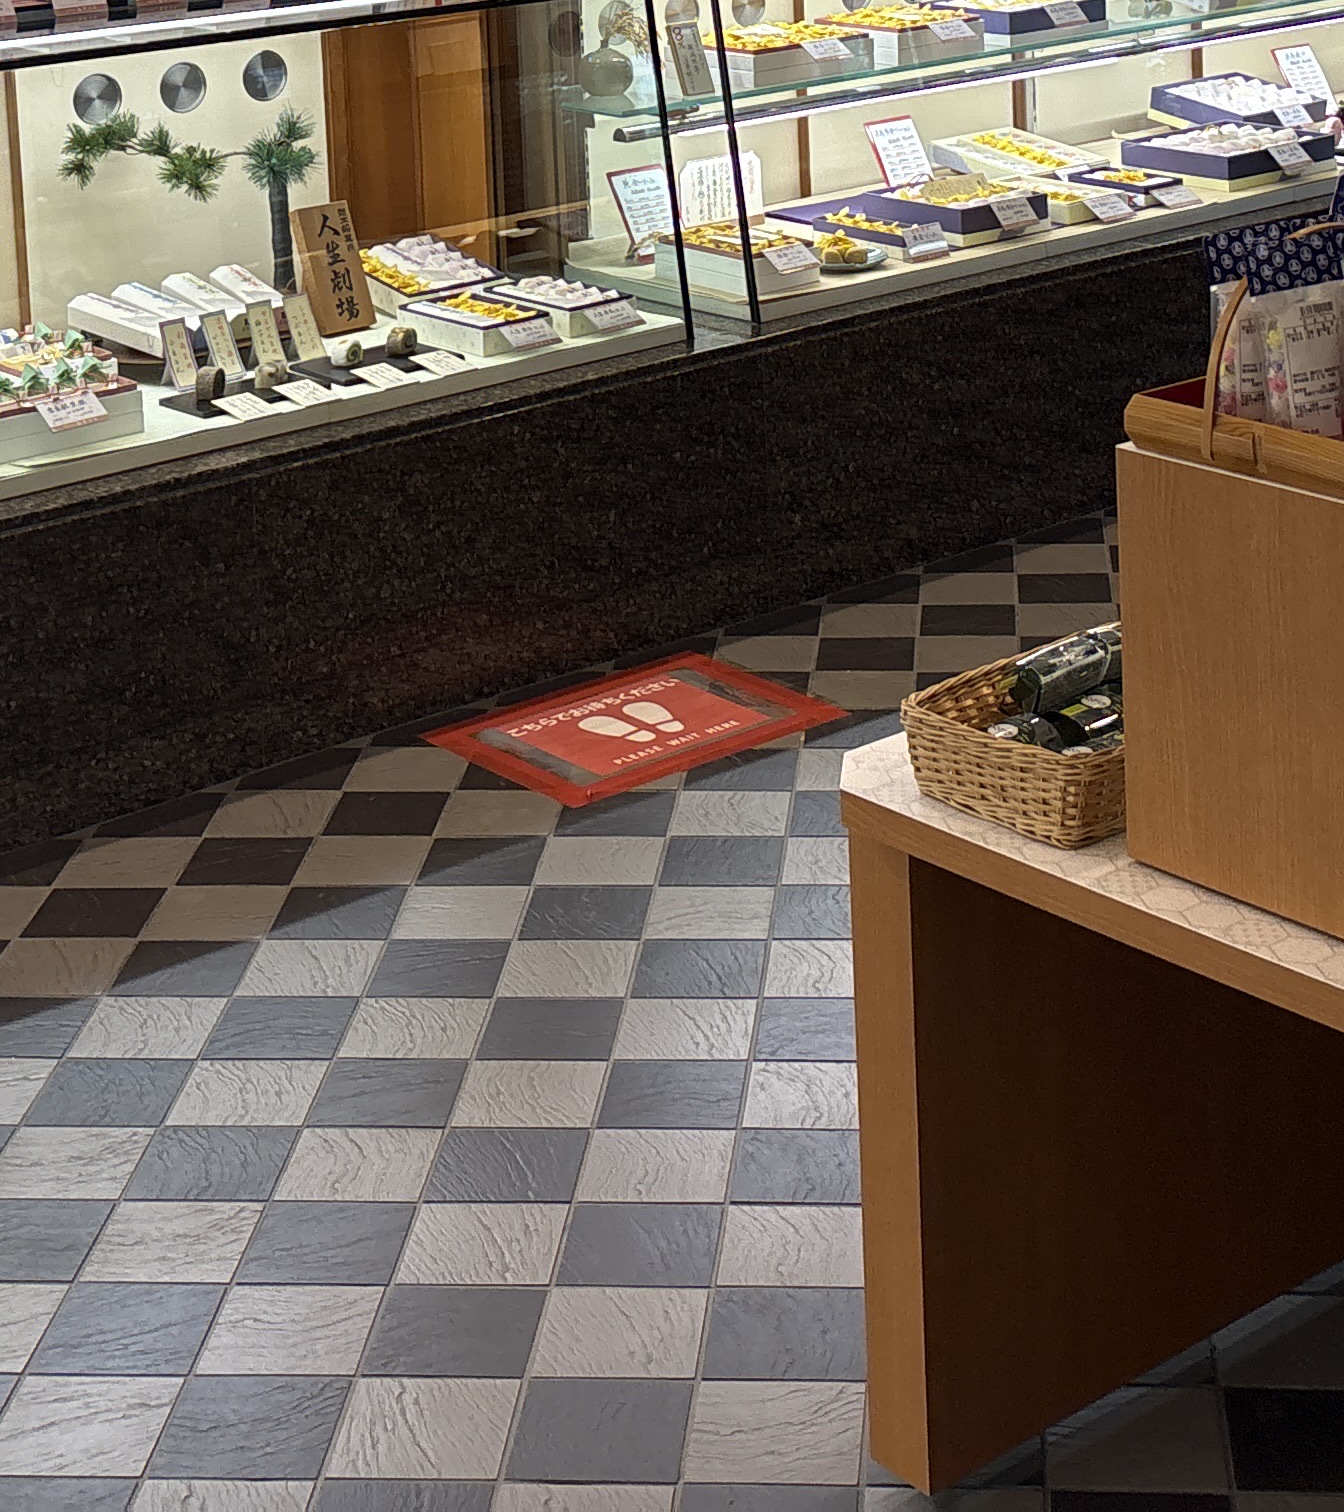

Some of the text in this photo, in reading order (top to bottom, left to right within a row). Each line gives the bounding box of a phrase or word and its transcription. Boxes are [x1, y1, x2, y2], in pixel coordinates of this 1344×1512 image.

[317, 212, 361, 323] 人生劇場
[506, 678, 680, 739] こちらでお待ちください
[613, 719, 740, 766] PLEASE WAIT HERE
